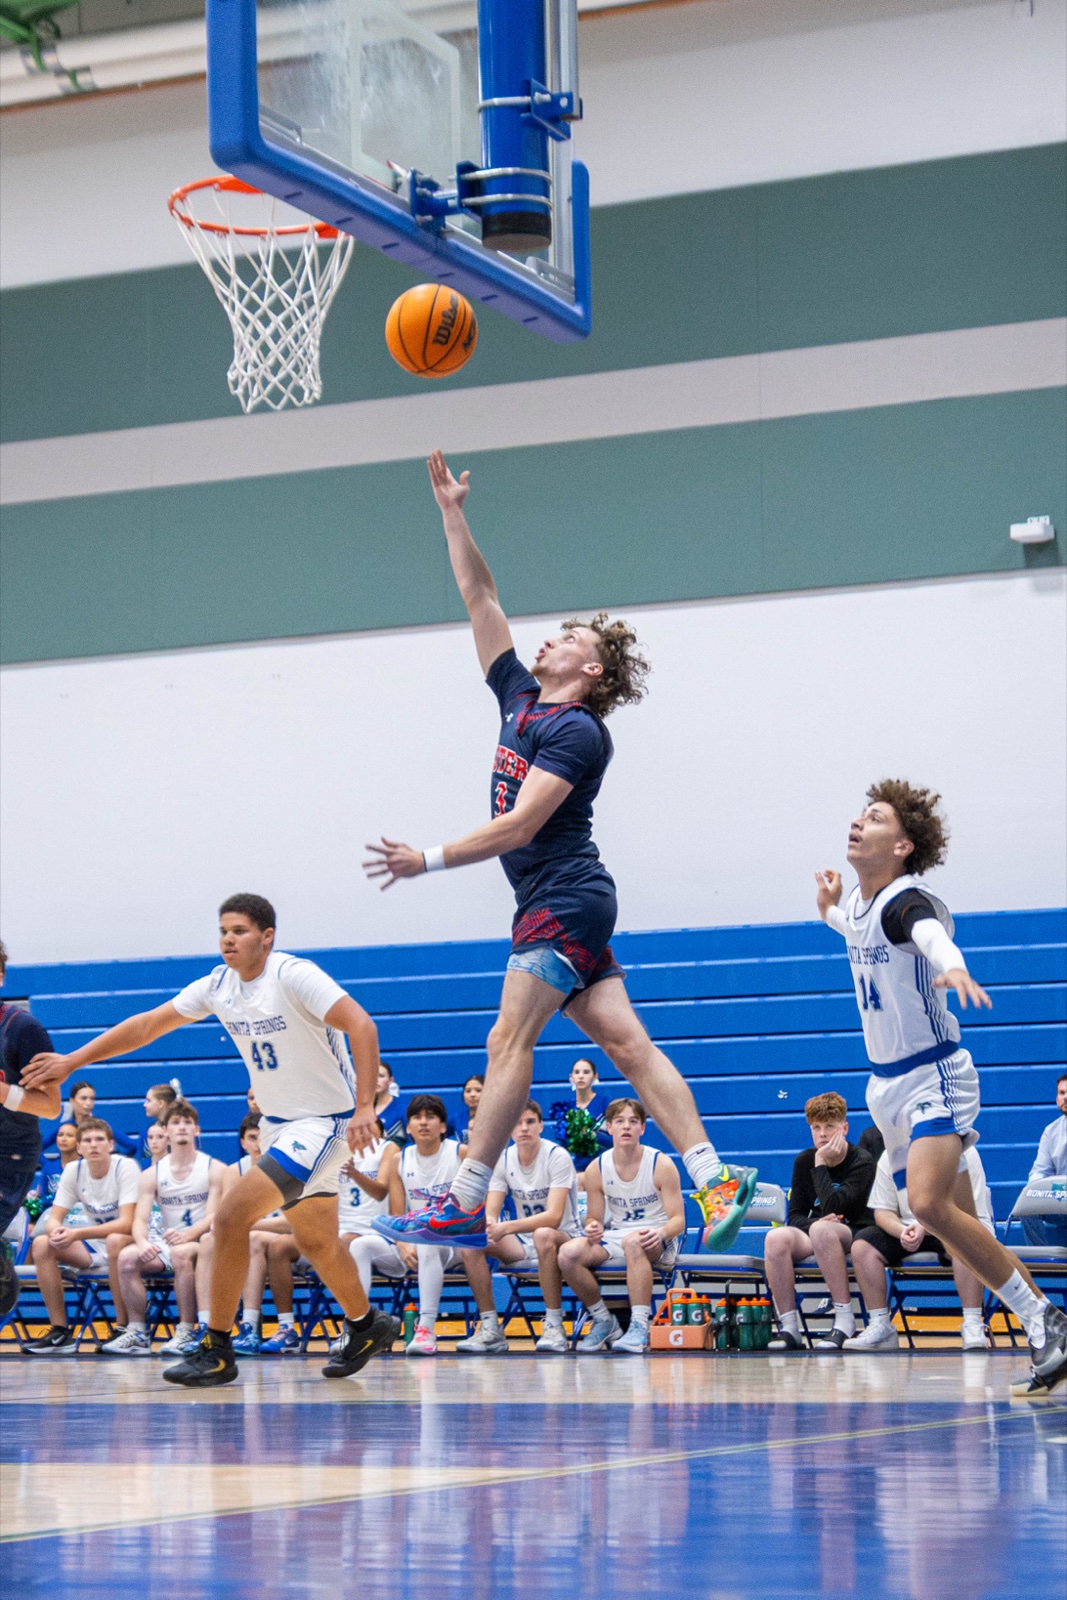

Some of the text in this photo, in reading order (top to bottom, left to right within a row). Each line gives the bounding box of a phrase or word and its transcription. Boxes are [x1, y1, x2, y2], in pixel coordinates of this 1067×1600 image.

[859, 974, 883, 1012] 14
[252, 1016, 287, 1035] SPRINGS
[251, 1041, 278, 1072] 43
[350, 1187, 361, 1207] 3
[629, 1192, 659, 1208] SPRINGS
[1026, 1189, 1053, 1198] BONITA
[182, 1208, 193, 1227] 4
[672, 1311, 683, 1322] G
[692, 1310, 702, 1322] G
[669, 1330, 684, 1346] G
